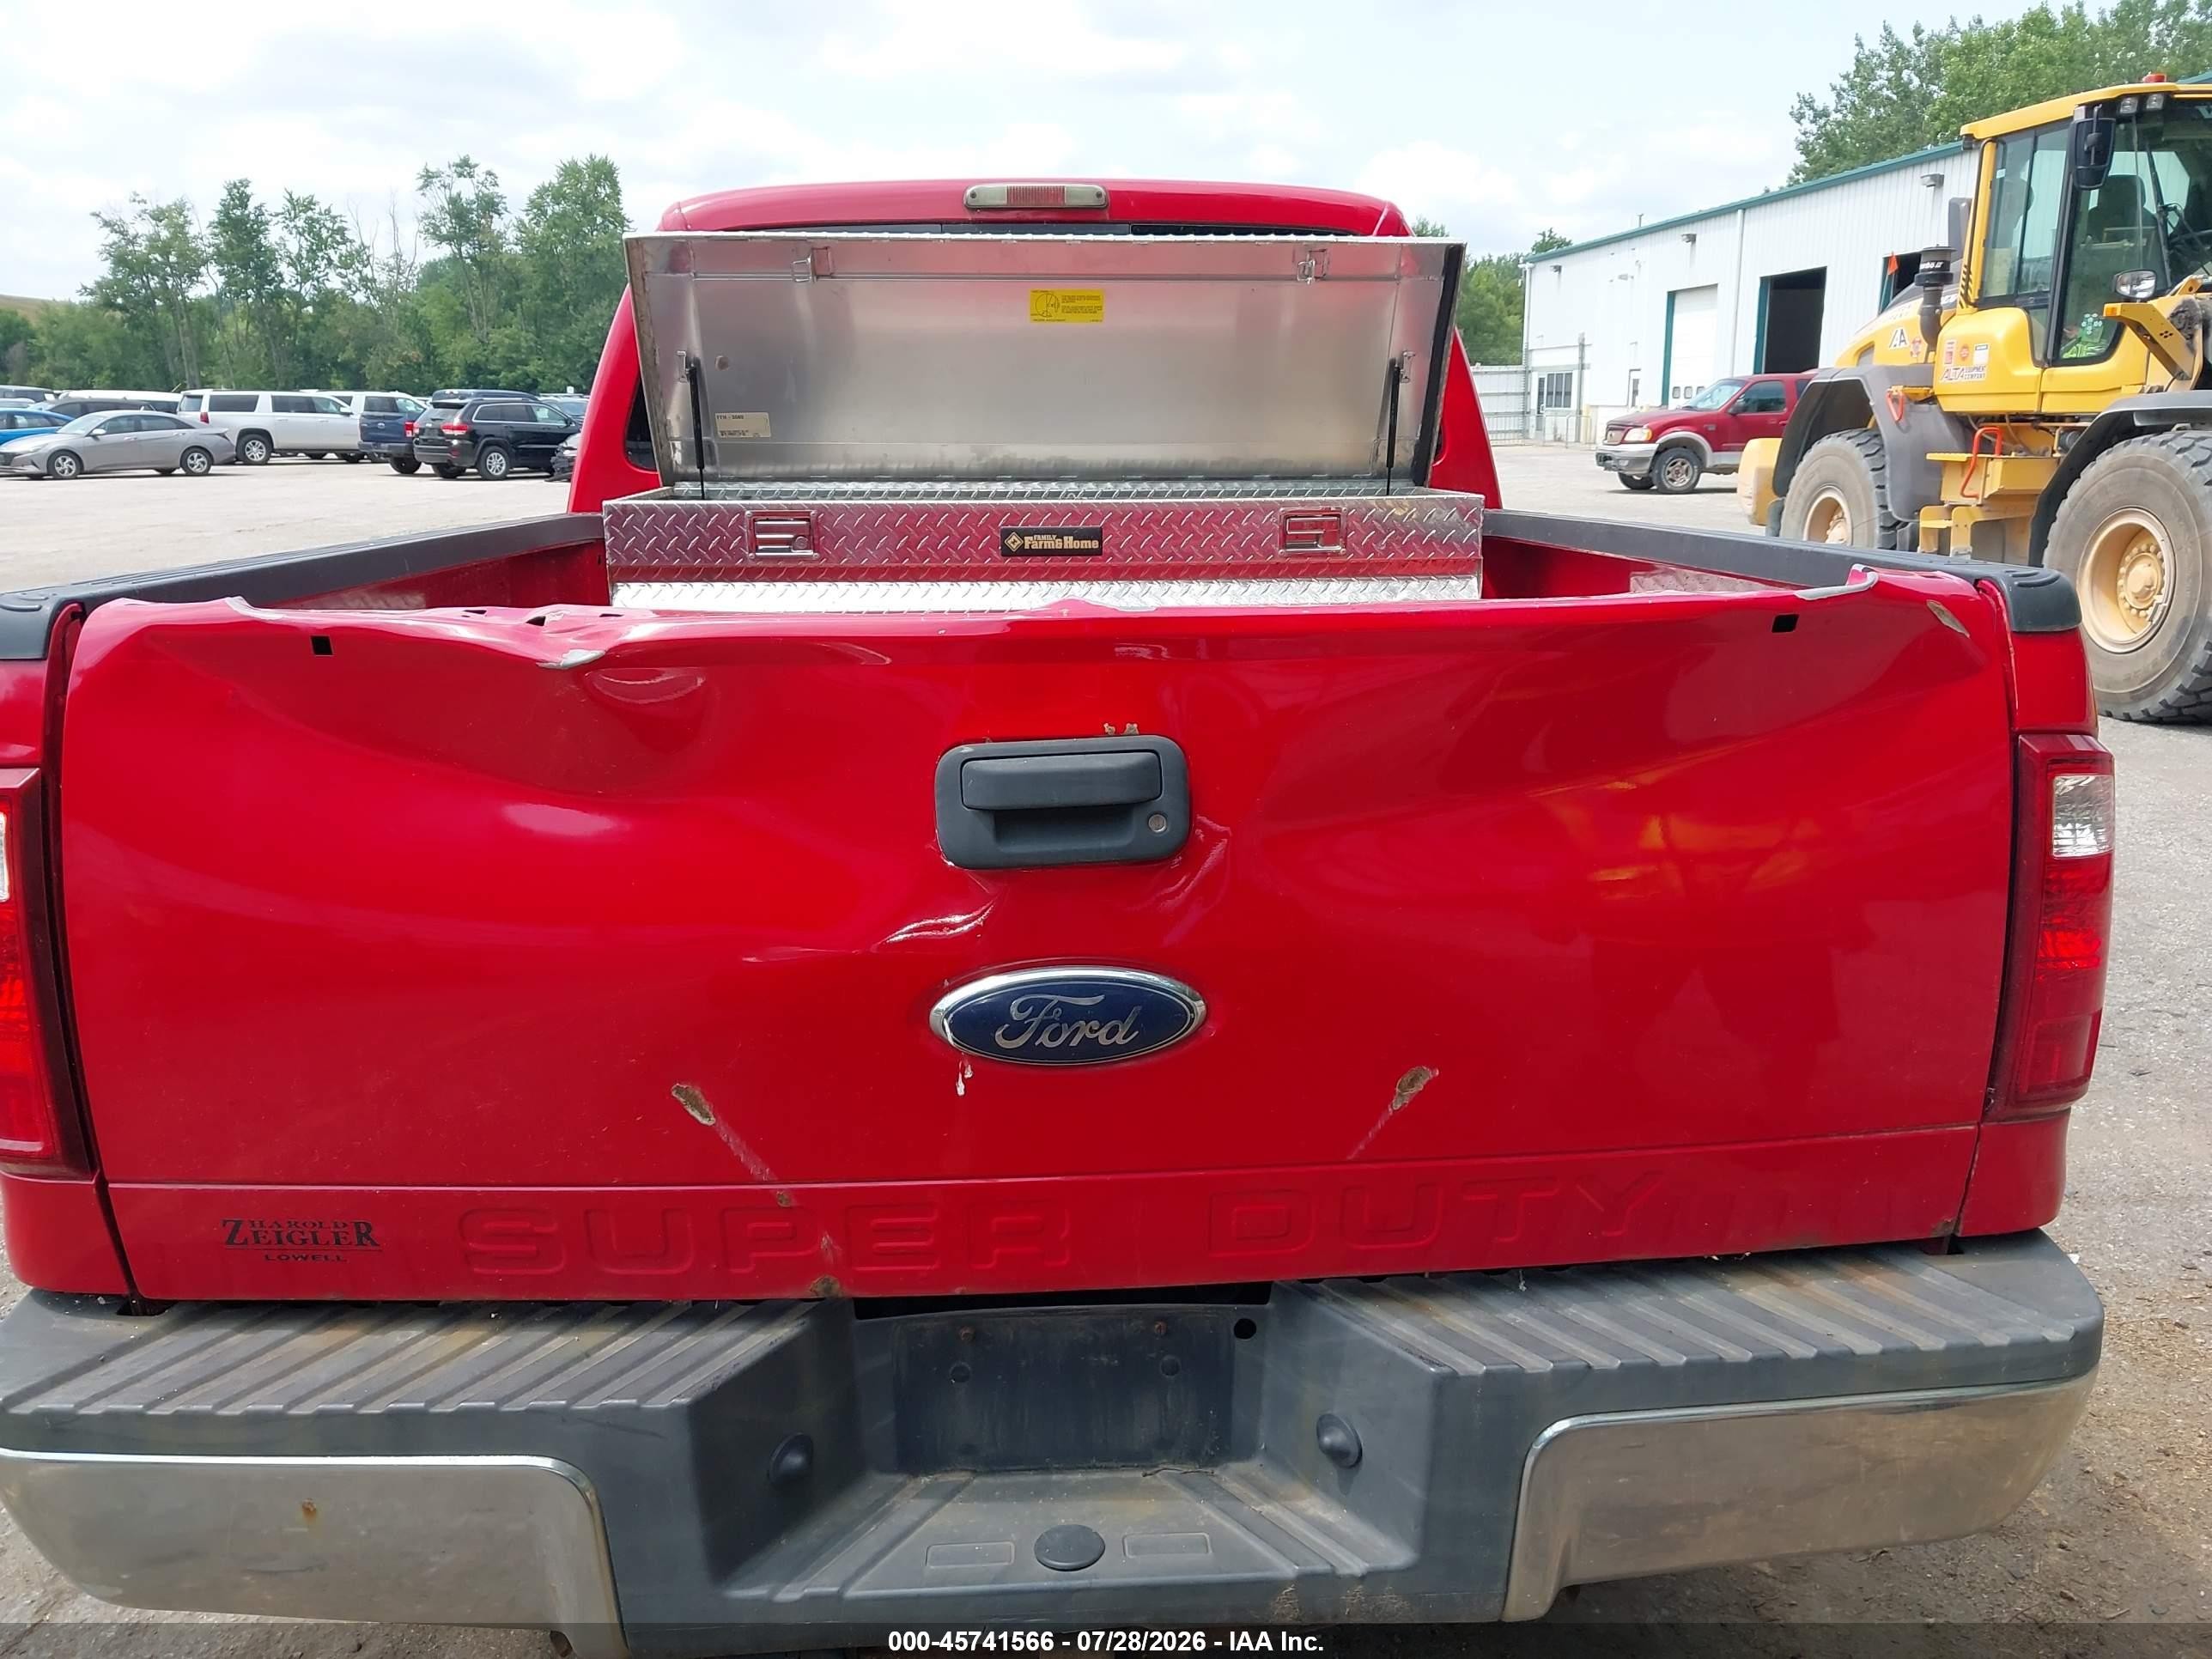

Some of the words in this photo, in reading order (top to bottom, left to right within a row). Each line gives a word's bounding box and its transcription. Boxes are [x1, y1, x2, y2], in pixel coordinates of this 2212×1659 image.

[994, 994, 1142, 1049] Ford
[222, 1218, 380, 1248] ZEIGLER
[250, 1219, 348, 1230] HAROLD
[457, 1199, 1071, 1276] SUPER
[1207, 1168, 1669, 1258] DUTY
[264, 1254, 348, 1262] LOWELL
